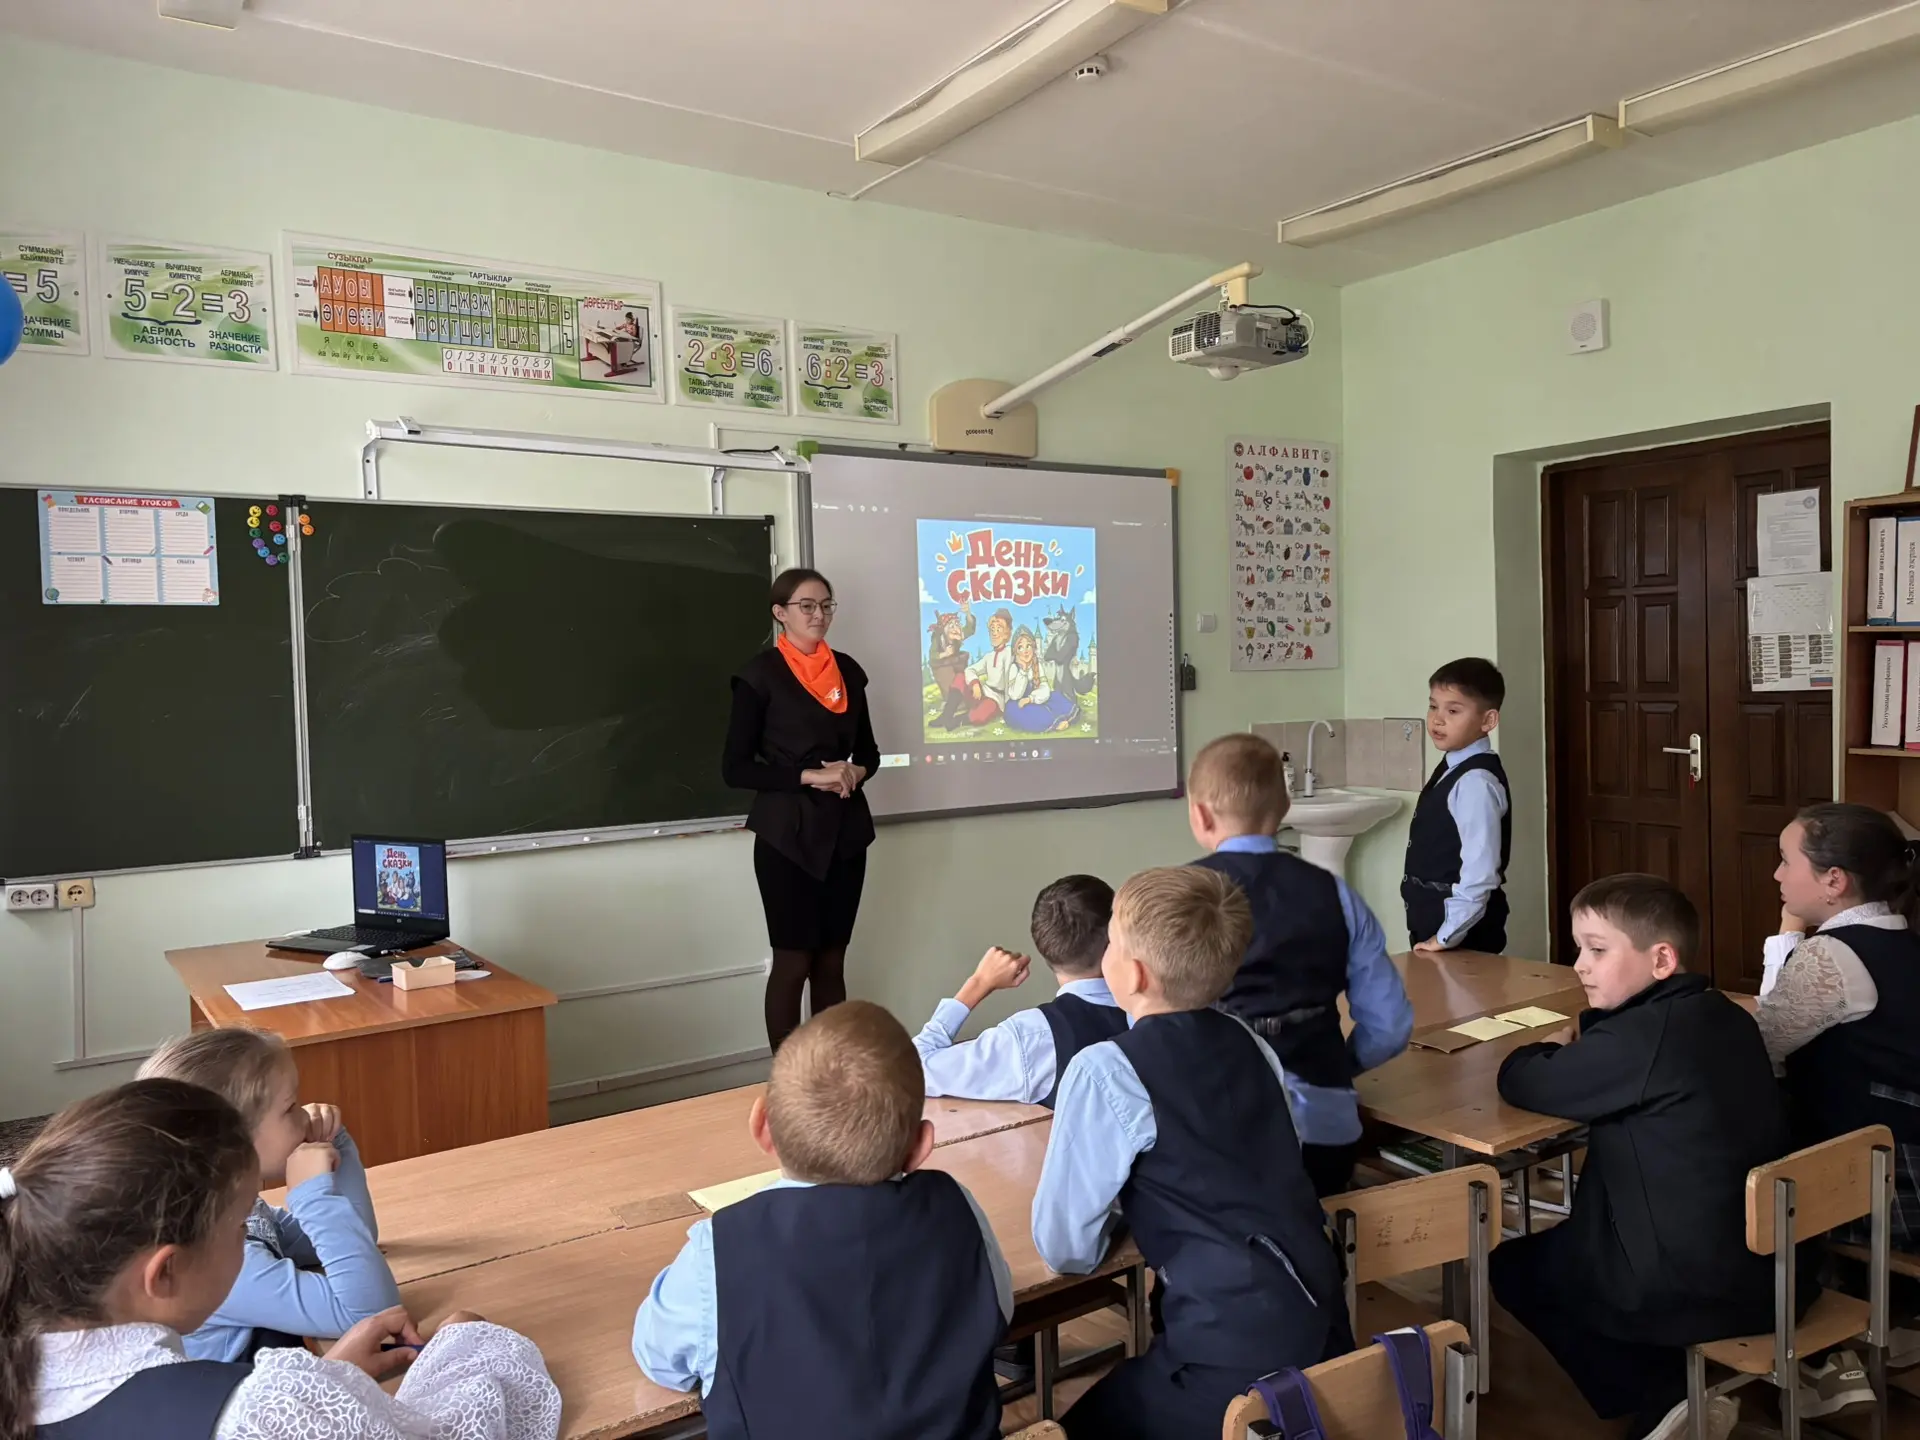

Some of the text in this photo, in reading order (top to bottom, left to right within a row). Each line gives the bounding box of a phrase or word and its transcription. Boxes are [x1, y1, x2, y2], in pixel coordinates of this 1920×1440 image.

[18, 244, 64, 257] СУММАНЫҢ
[327, 252, 373, 264] СУЗЫКЛАР
[165, 262, 202, 274] ВЫЧИТАЕМОЕ
[469, 272, 512, 282] ТАРТЫКЛАР
[23, 315, 71, 328] НАЧЕНИЕ
[22, 327, 64, 339] СУММЫ
[142, 326, 183, 337] АЕРМА
[209, 330, 261, 343] ЗНАЧЕНИЕ
[133, 334, 196, 348] РАЗНОСТЬ
[209, 341, 262, 354] РАЗНОСТИ
[445, 350, 550, 368] 0 1 2 3 4 5 6 7 8 9
[689, 386, 734, 398] ПРОИЗВЕДЕНИЕ
[814, 399, 844, 408] ЧАСТНОЕ
[1247, 444, 1319, 460] АЛФАВИТ
[966, 528, 1048, 570] День
